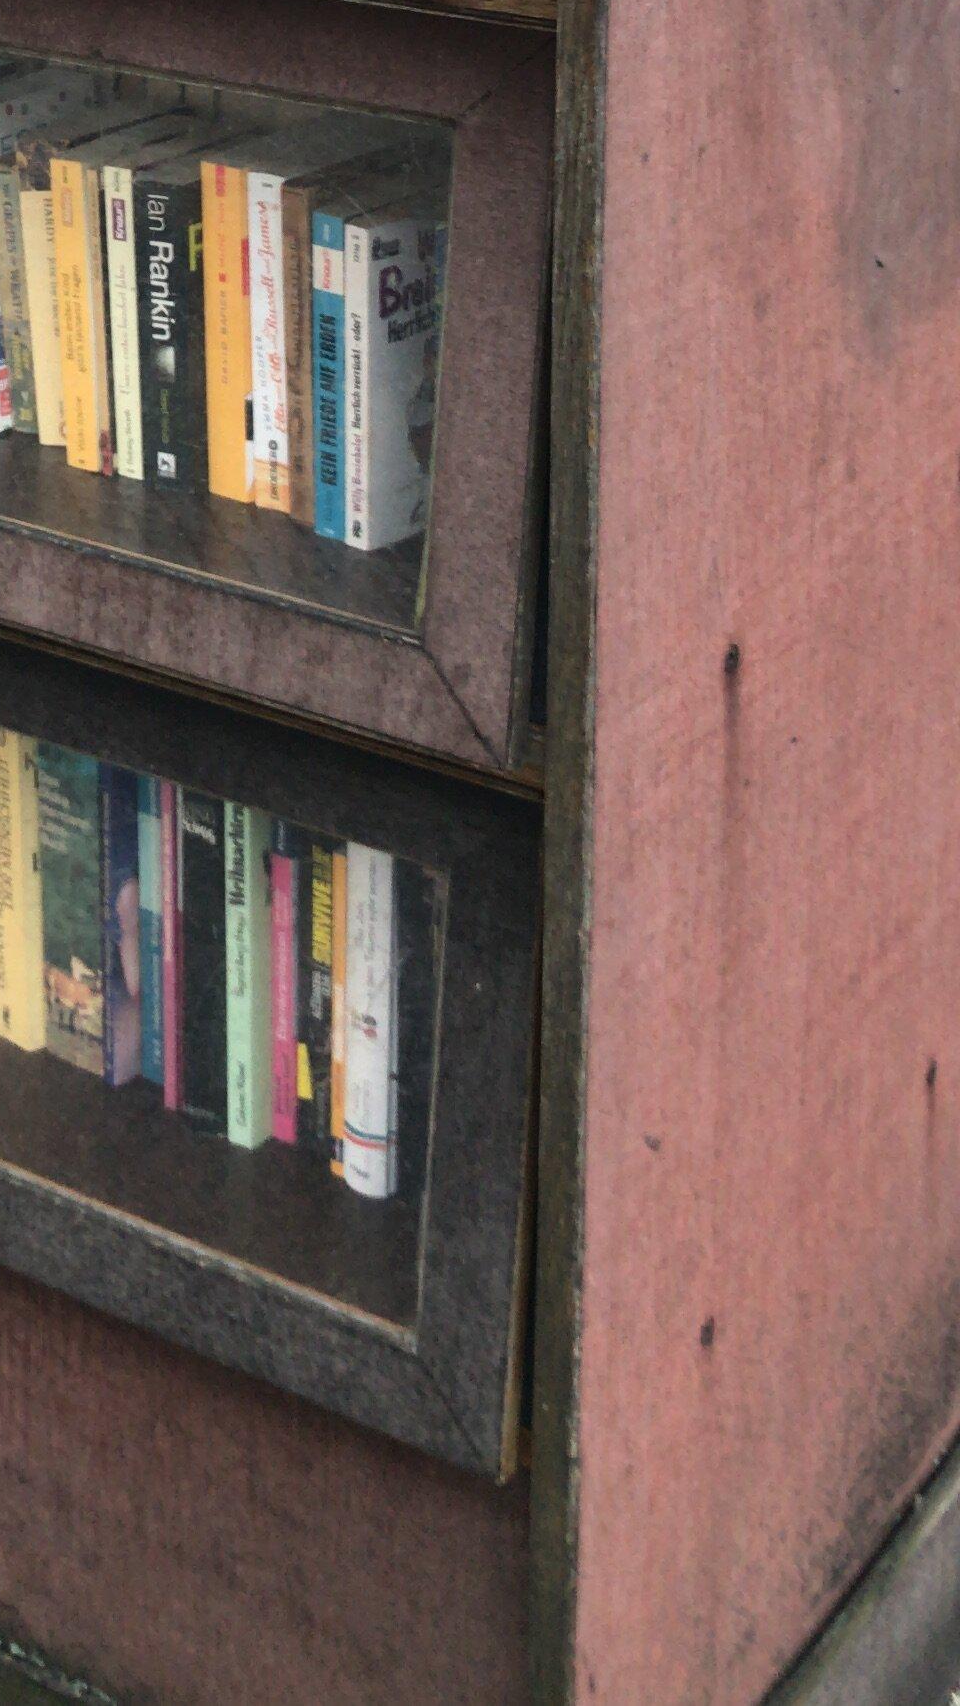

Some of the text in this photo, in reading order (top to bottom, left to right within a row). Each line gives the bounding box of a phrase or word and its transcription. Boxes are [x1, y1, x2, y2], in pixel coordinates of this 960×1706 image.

[2, 201, 17, 255] GRAPES
[42, 197, 55, 244] HARDY
[60, 273, 71, 298] Kind
[70, 264, 83, 300] Fragen
[147, 193, 176, 341] Ian Rankin
[259, 275, 276, 331] Russell
[349, 312, 362, 342] oder?
[349, 350, 361, 390] verrückt
[319, 313, 337, 486] KEIN FRIEDE AUF ERDEN
[349, 391, 362, 430] Herrlich
[349, 488, 362, 514] Willy
